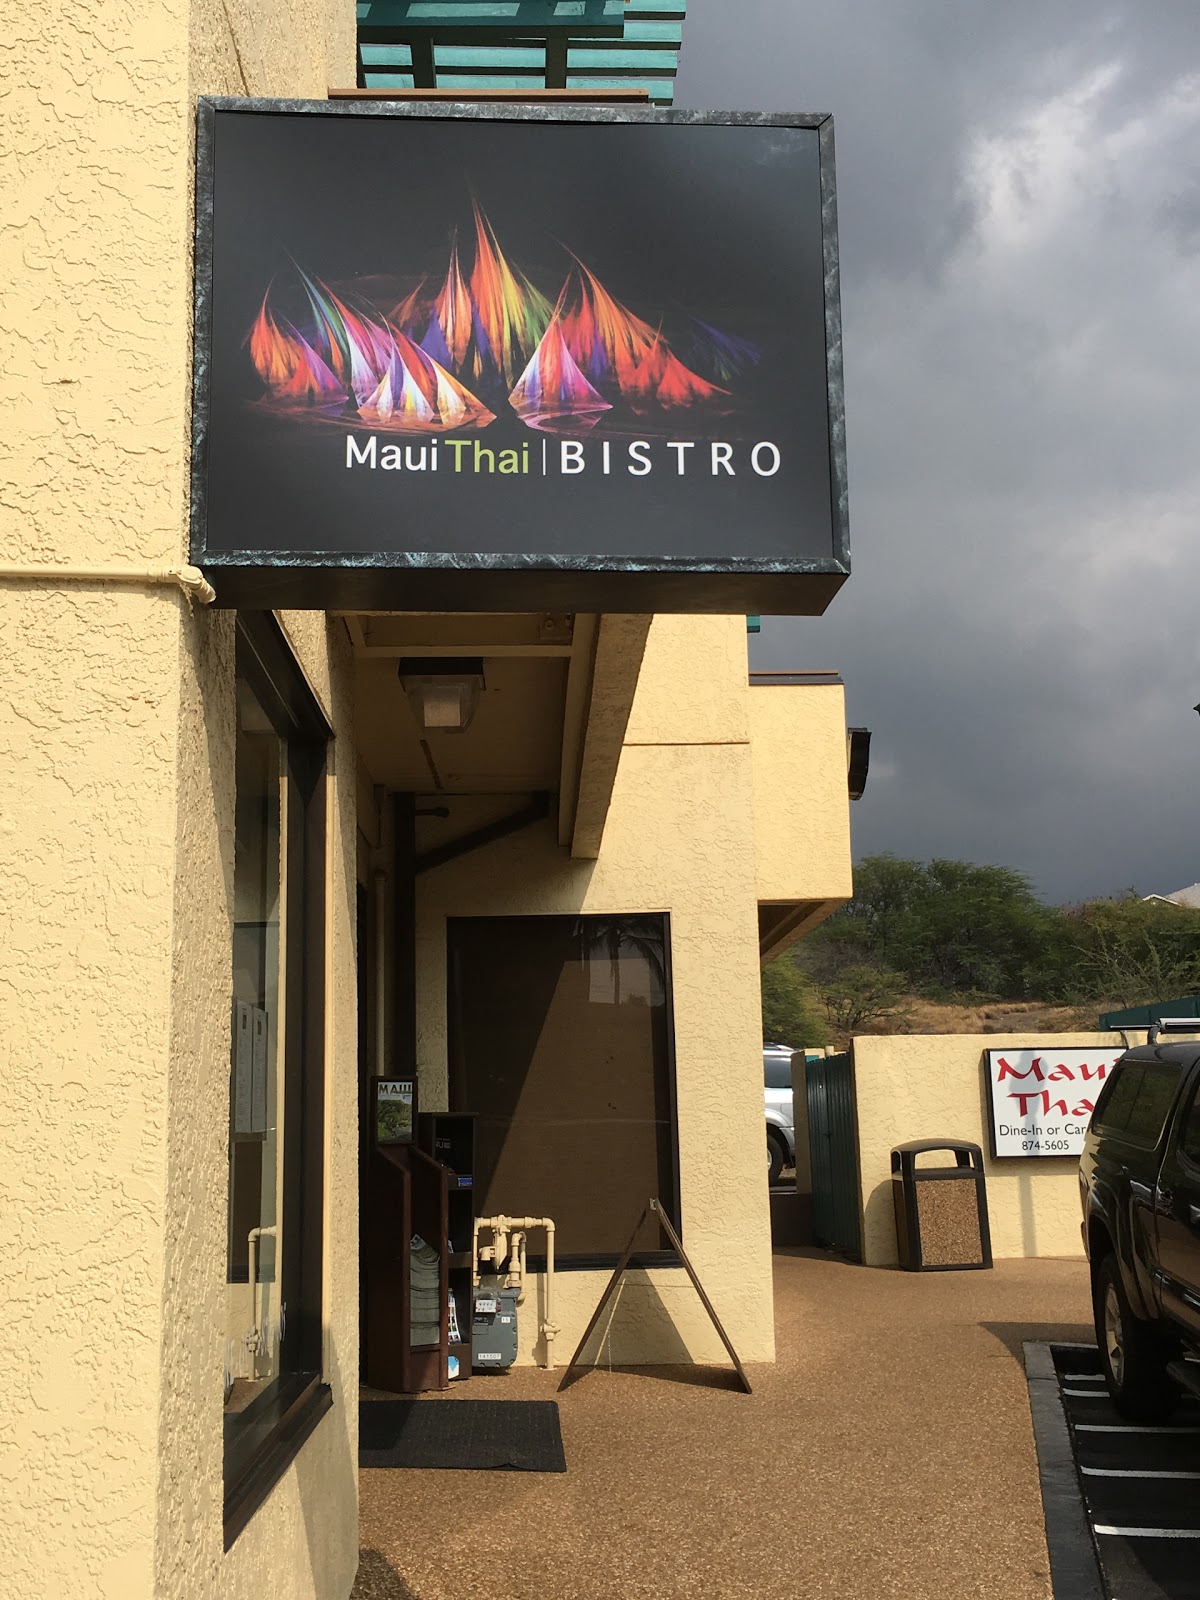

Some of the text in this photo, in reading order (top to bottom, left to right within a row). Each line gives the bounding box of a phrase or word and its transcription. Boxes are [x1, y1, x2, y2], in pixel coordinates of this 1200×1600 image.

[344, 435, 781, 476] Maui Thai BISTRO
[997, 1057, 1120, 1082] Mau
[379, 1084, 412, 1094] MAUI
[1006, 1089, 1095, 1117] Tha
[999, 1124, 1087, 1136] Dine-In or Car
[1022, 1140, 1069, 1151] 874-5605
